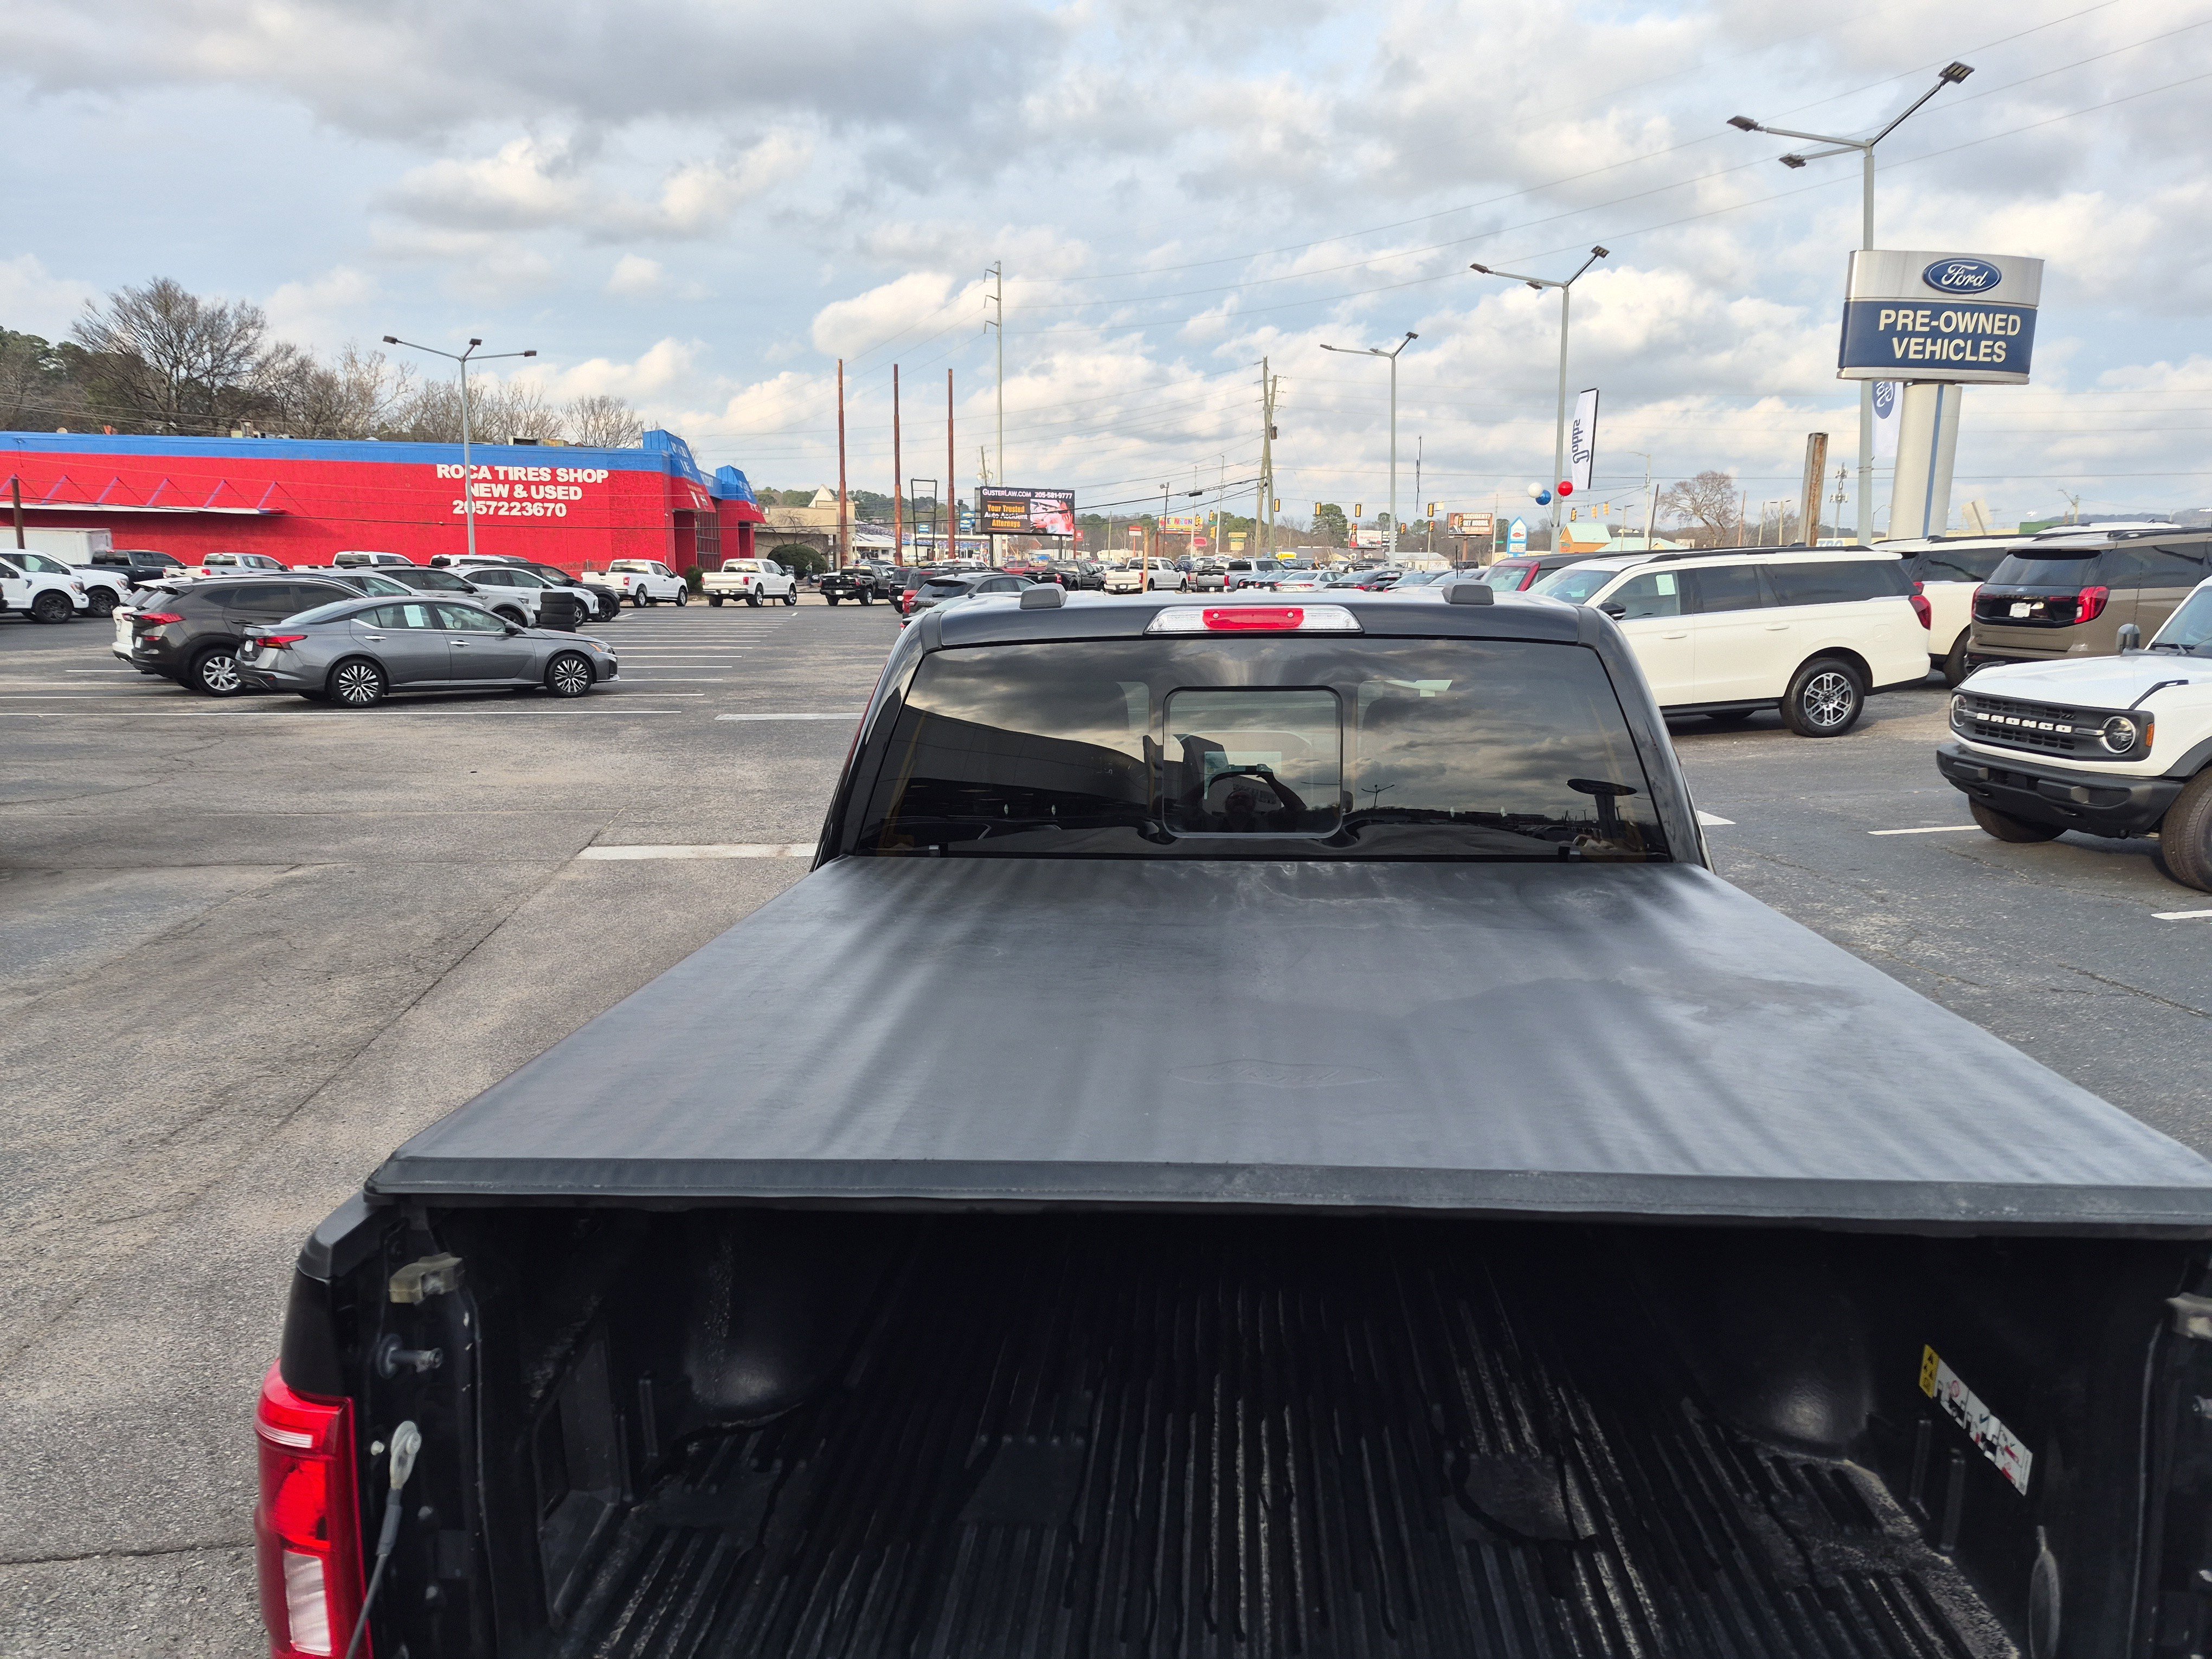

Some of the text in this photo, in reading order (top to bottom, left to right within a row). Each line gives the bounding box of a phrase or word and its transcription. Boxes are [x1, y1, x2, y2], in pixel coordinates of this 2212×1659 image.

[1941, 264, 1989, 287] Ford
[1879, 310, 2021, 336] PRE-OWNED
[1892, 337, 2007, 363] VEHICLES
[436, 464, 609, 484] ROCA TIRES SHOP
[465, 482, 583, 500] NEW & USED
[452, 500, 567, 517] 2057223670
[987, 504, 1025, 513] Your Trusted
[992, 519, 1020, 528] Attorneys
[1977, 712, 2072, 733] BRONCO
